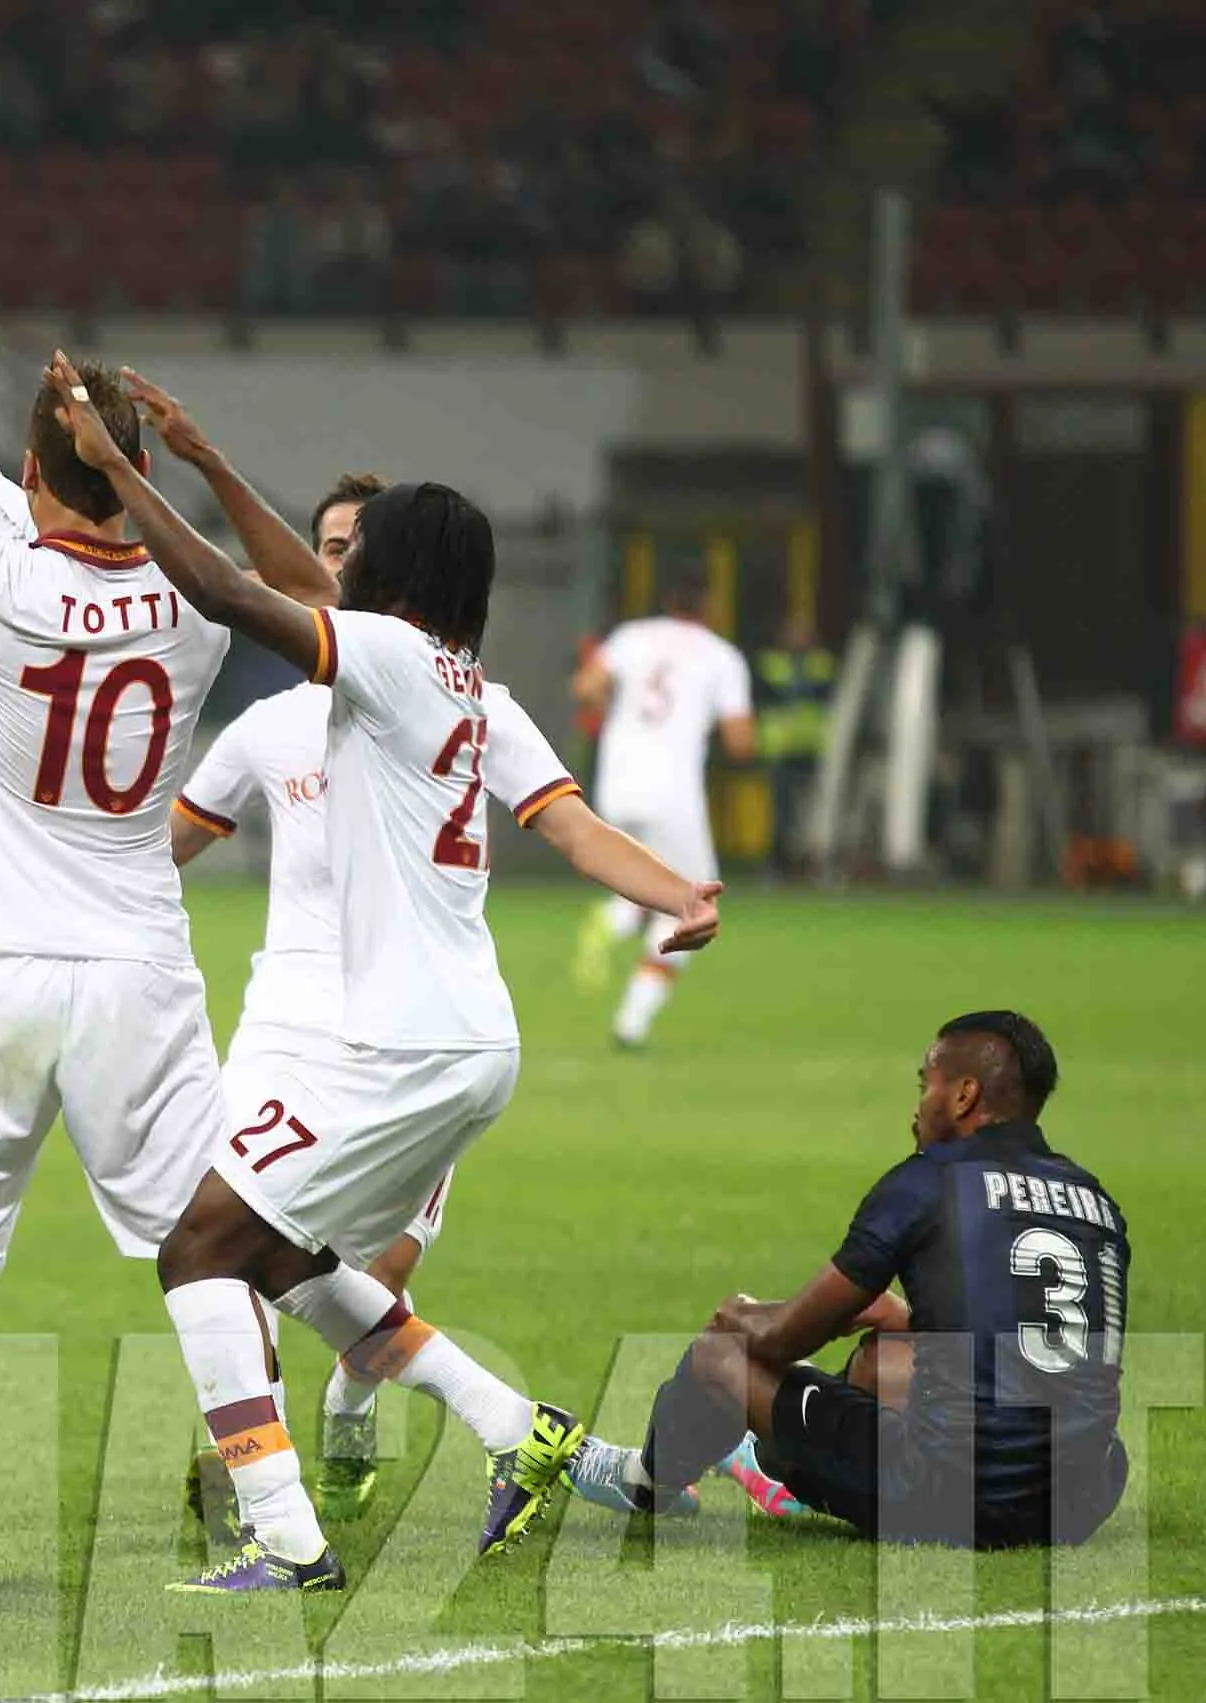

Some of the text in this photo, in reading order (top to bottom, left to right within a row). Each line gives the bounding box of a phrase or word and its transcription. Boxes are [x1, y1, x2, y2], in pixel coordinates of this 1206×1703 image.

[61, 591, 179, 634] TOTTI
[19, 648, 172, 814] 10
[230, 1099, 318, 1174] 27
[1010, 1227, 1123, 1373] 31
